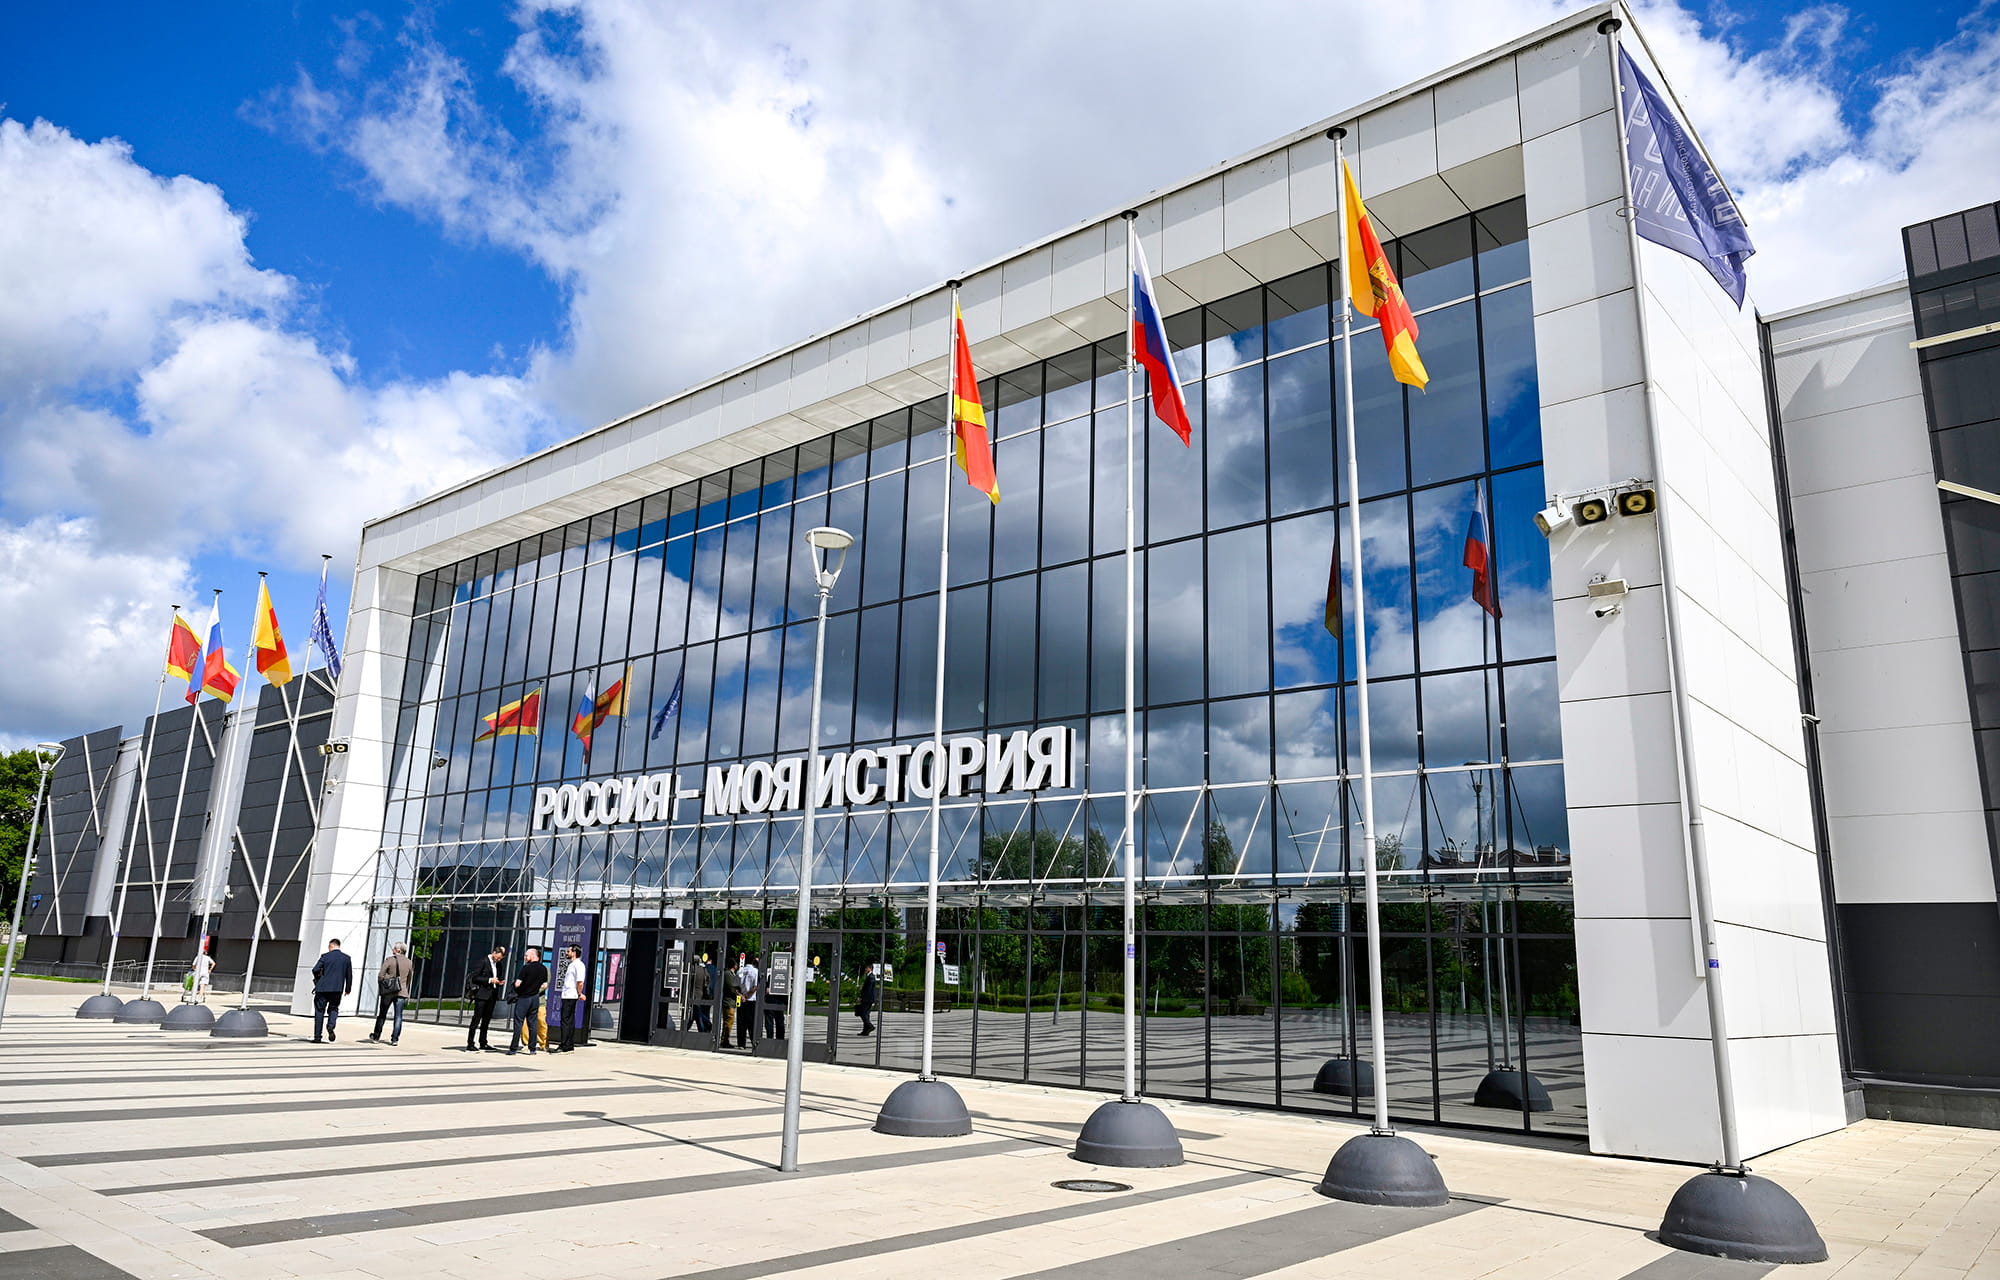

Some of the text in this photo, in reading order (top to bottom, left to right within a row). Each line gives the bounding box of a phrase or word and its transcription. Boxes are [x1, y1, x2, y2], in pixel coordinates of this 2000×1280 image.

[533, 772, 672, 830] РОССИЯ
[704, 757, 803, 816] МОЯ
[815, 726, 1067, 808] ИСТОРИЯ
